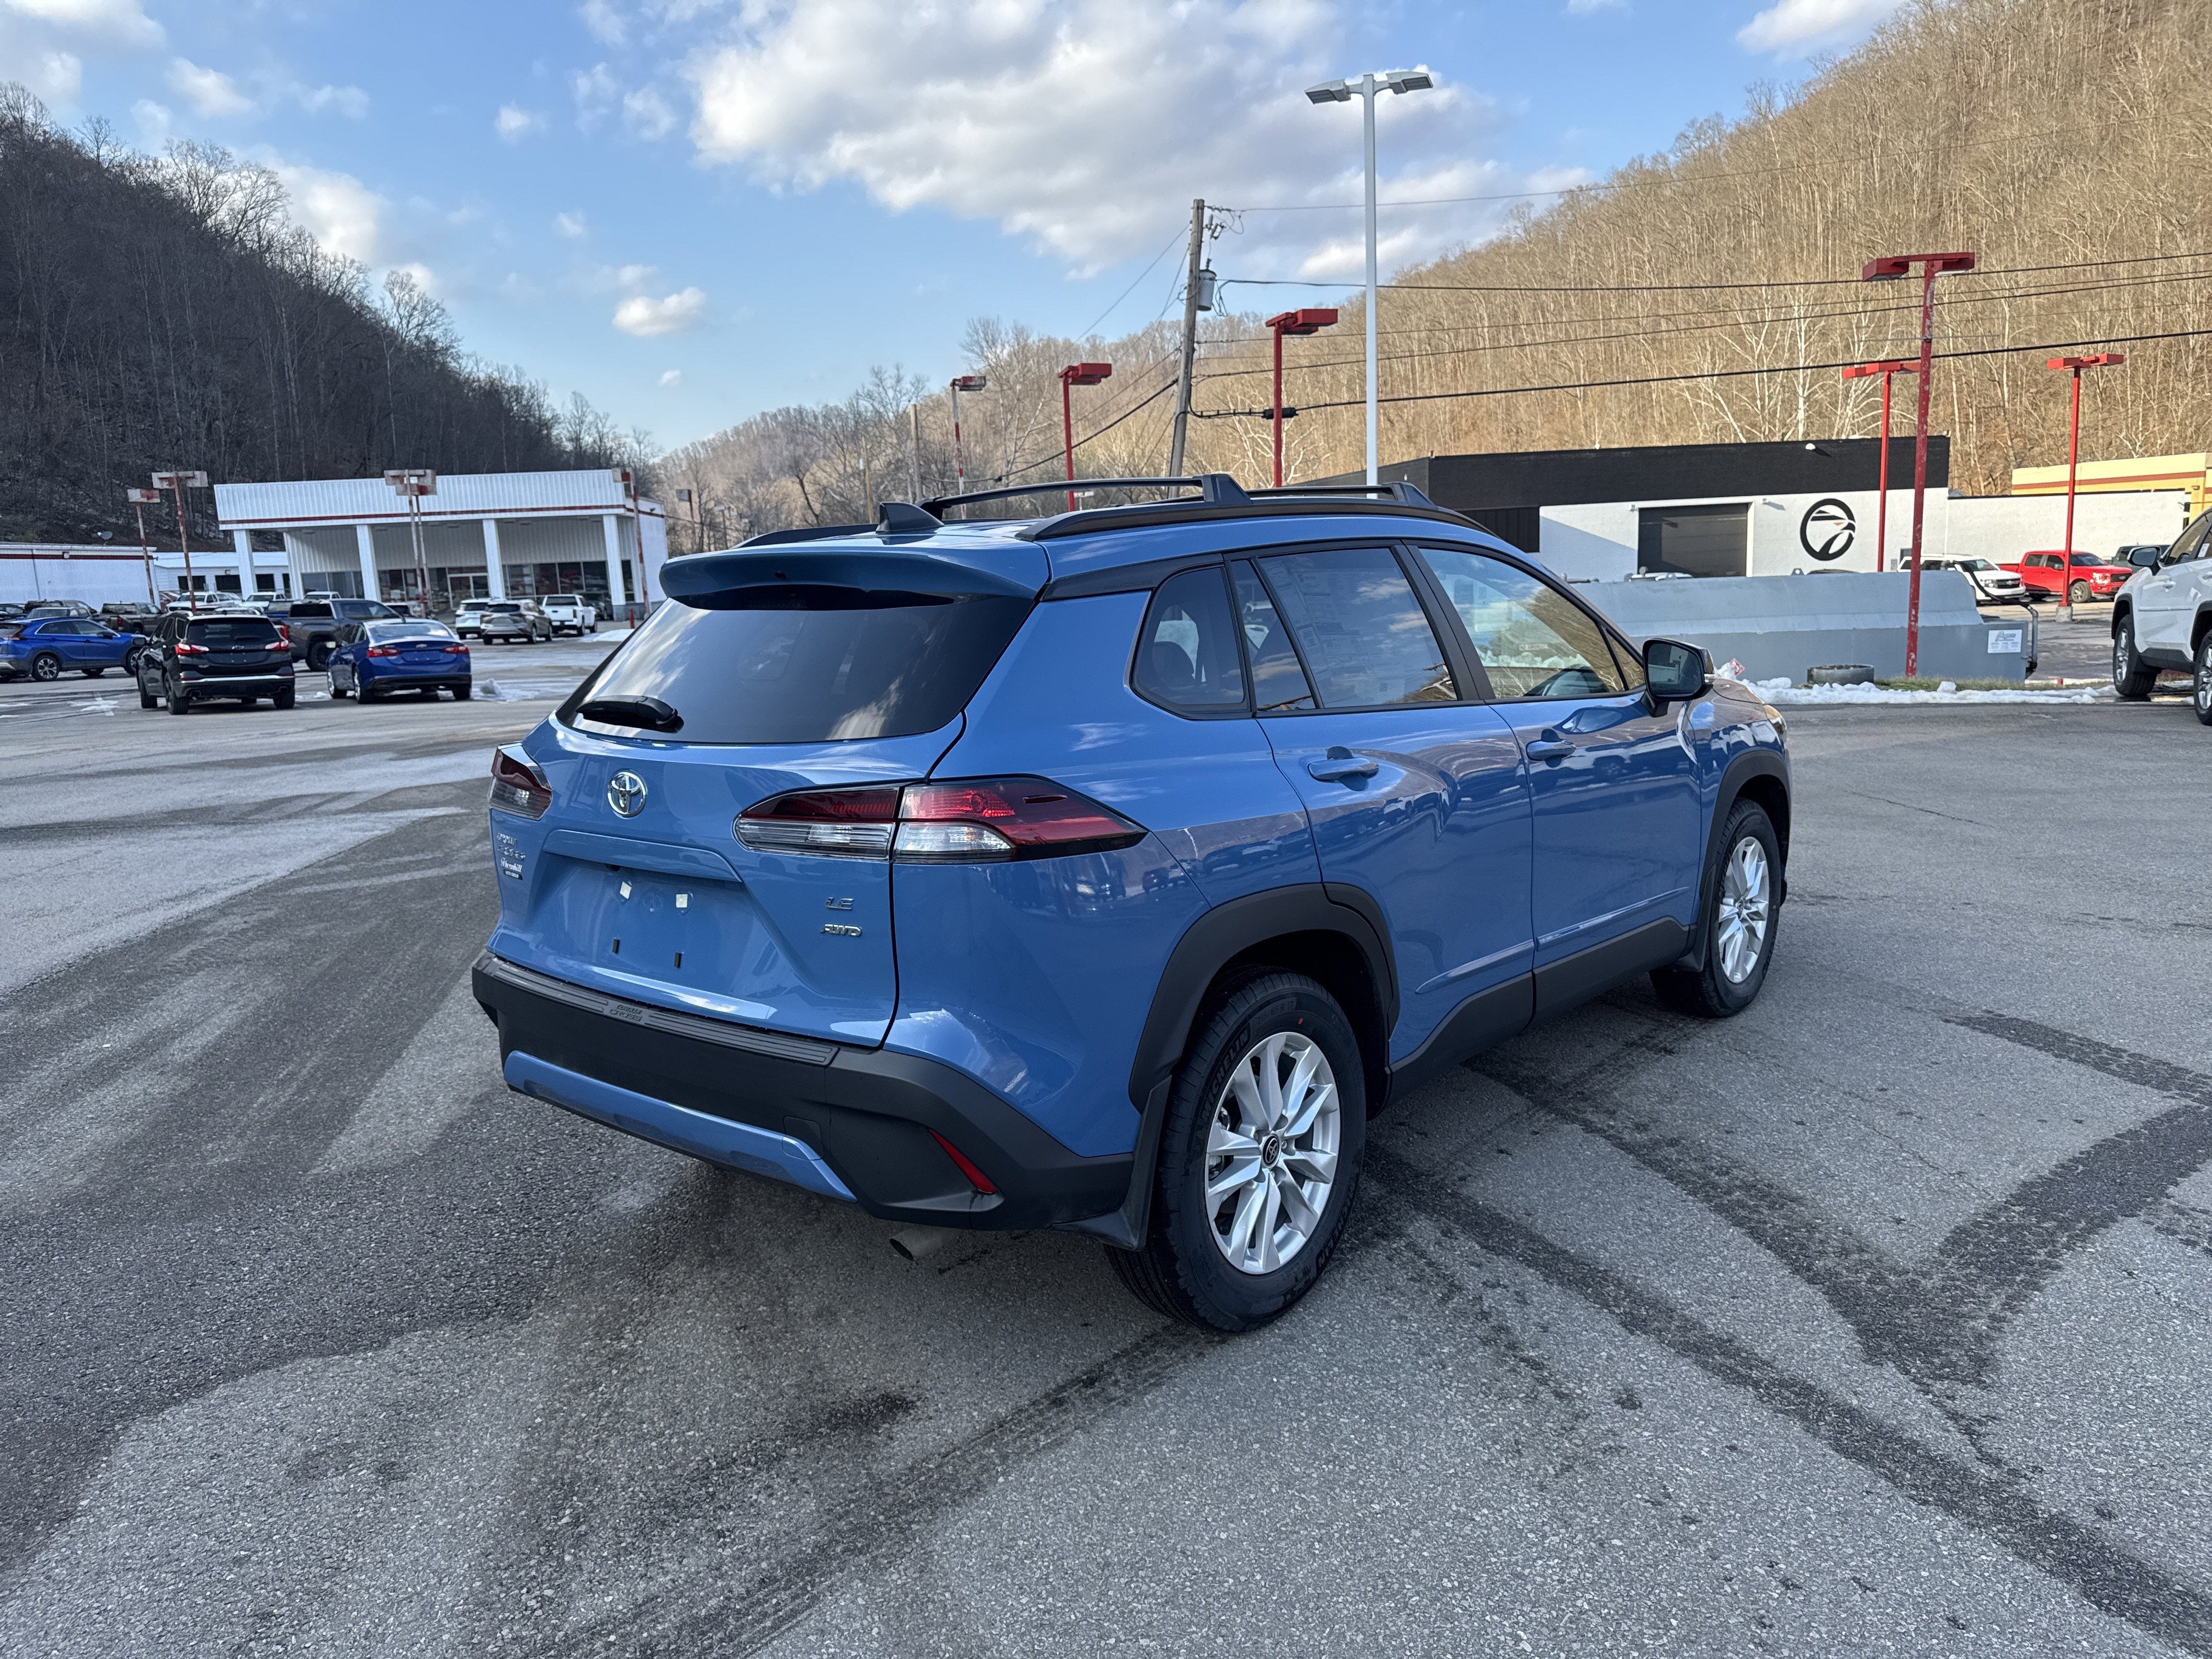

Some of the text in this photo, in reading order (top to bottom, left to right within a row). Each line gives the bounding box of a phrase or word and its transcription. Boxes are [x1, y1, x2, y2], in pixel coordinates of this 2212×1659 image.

[825, 897, 854, 911] LE
[820, 924, 862, 936] AWD
[610, 1009, 643, 1021] CROSS
[1201, 1029, 1249, 1122] MICHELIN
